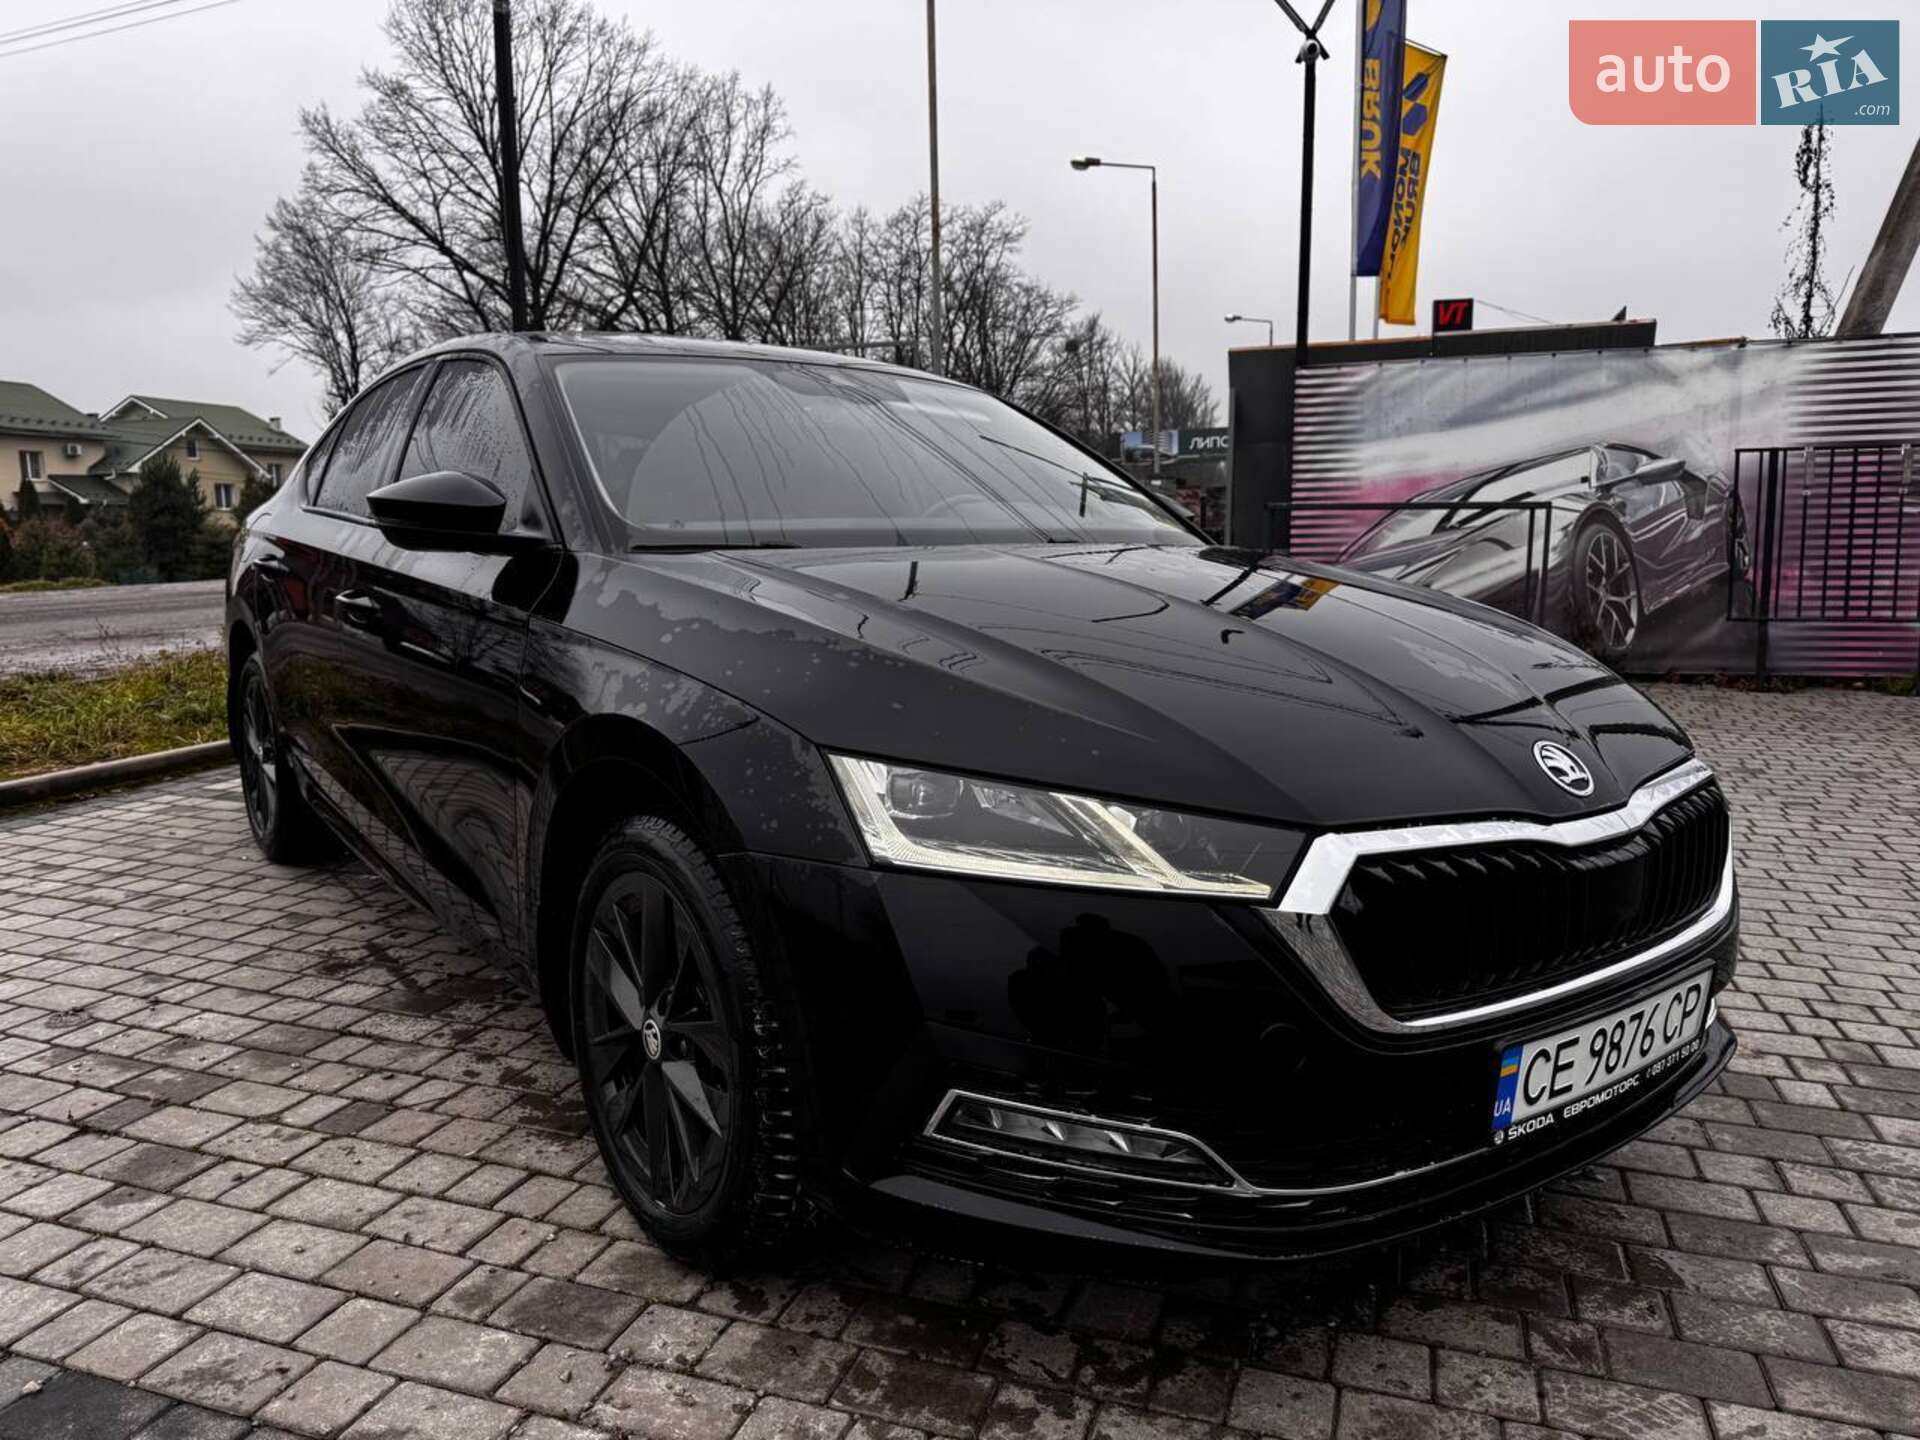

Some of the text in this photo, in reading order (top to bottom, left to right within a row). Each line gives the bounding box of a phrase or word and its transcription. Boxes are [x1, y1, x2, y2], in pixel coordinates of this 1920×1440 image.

[1439, 302, 1469, 326] VT
[1523, 983, 1701, 1106] CE 9876 CP
[1494, 1097, 1512, 1118] UA
